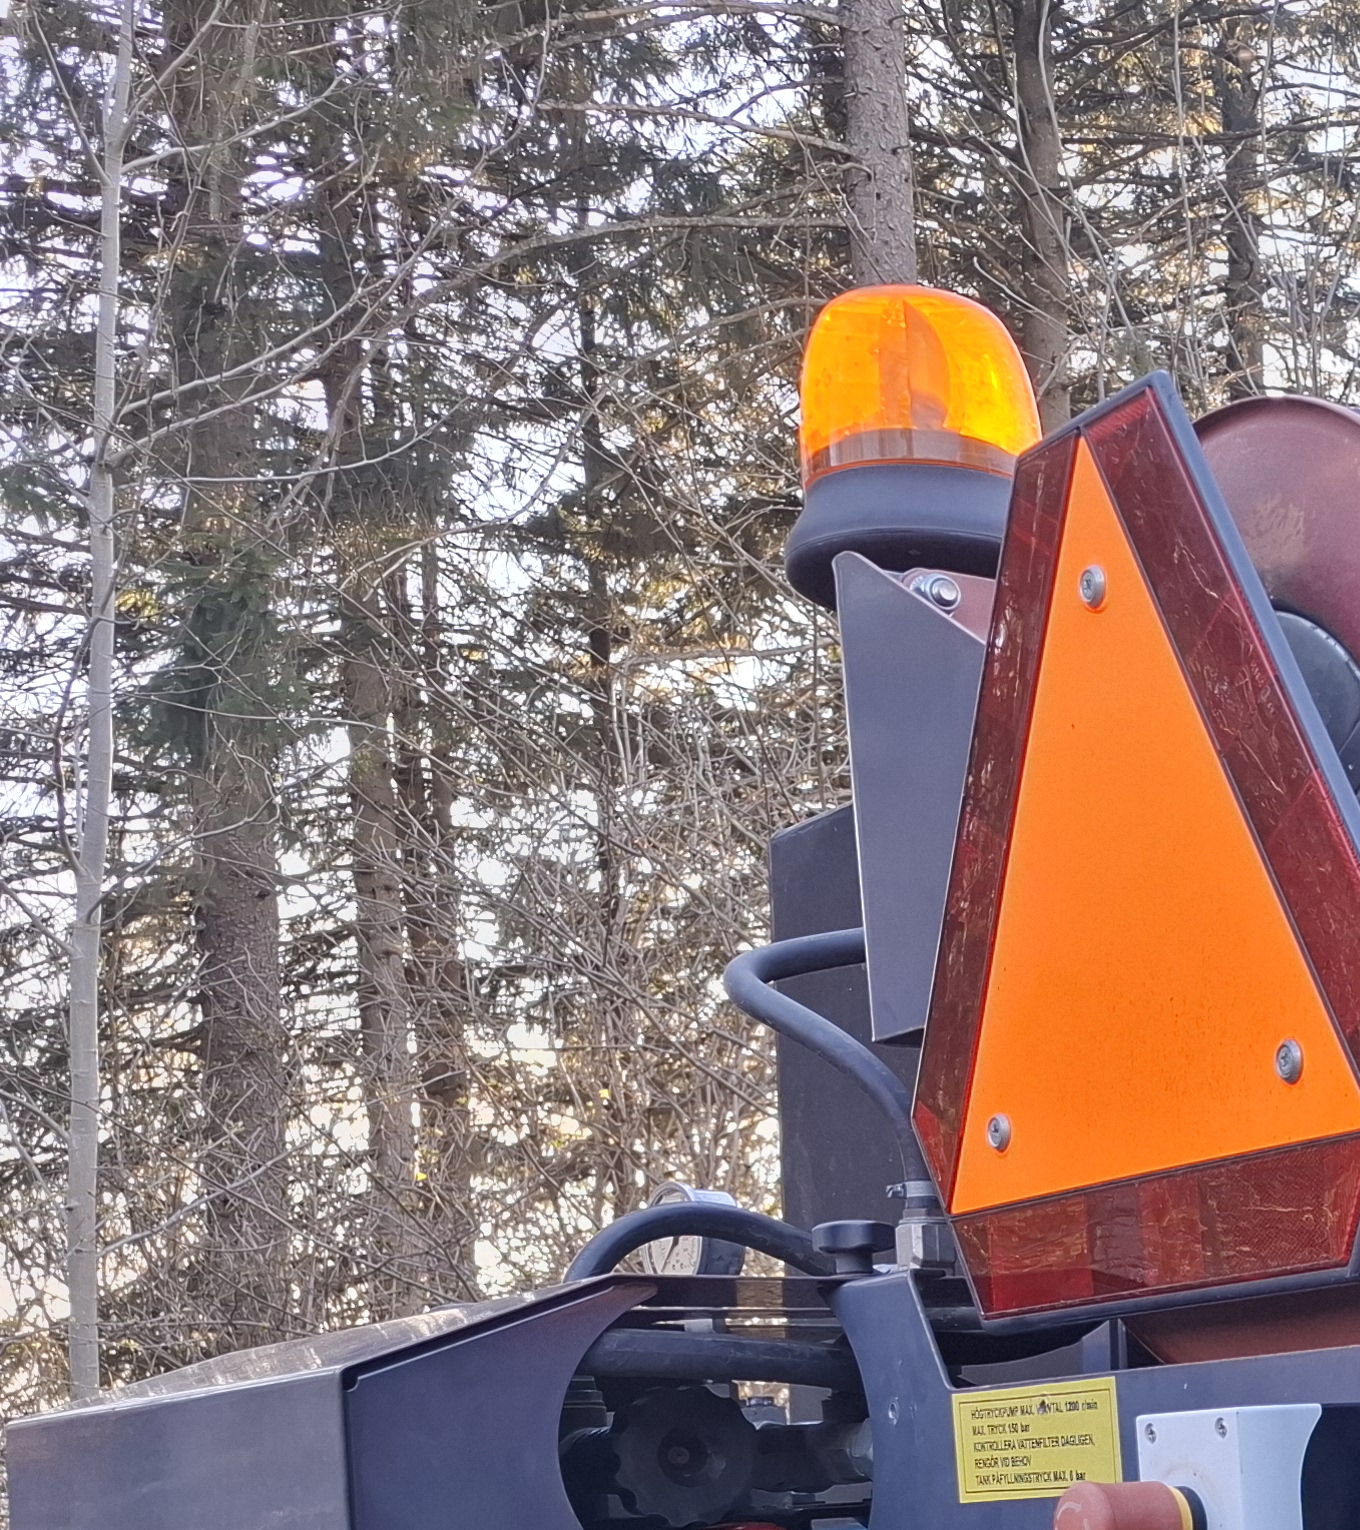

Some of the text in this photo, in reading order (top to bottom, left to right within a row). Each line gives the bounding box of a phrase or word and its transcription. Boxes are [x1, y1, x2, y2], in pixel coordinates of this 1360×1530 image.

[987, 1424, 1007, 1435] TRYCK
[1008, 1423, 1018, 1434] 150
[1020, 1422, 1030, 1433] bar
[1000, 1457, 1010, 1468] VID
[1011, 1455, 1031, 1467] BEHOV
[1075, 1469, 1086, 1481] bar
